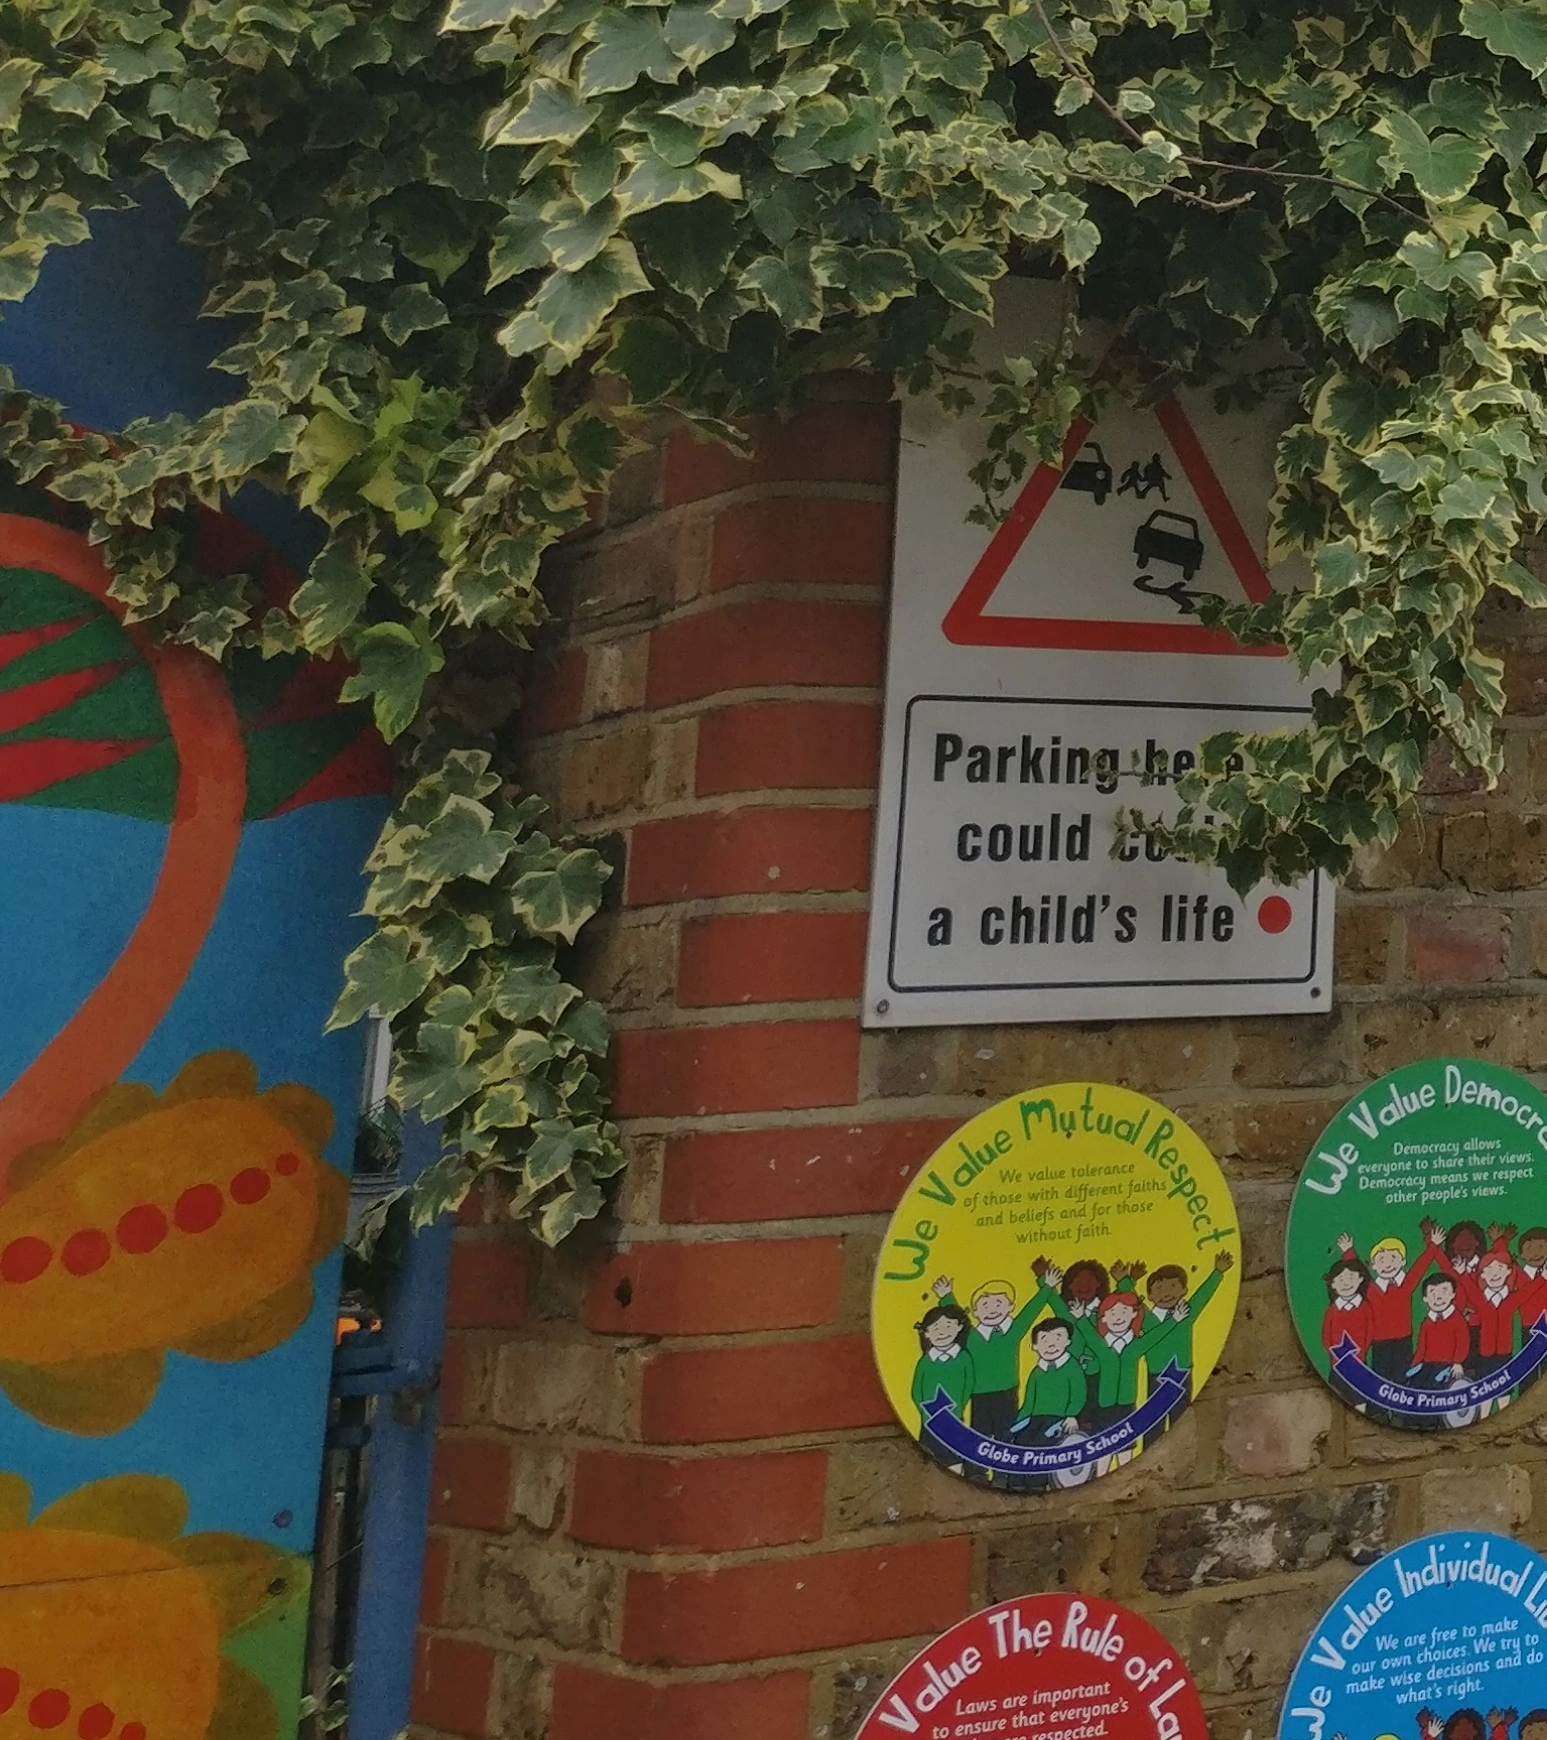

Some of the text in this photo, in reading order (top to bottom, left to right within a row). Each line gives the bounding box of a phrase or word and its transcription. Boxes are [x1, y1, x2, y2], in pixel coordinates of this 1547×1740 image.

[932, 733, 1244, 795] Parking hee
[956, 813, 1092, 864] could
[927, 892, 1235, 946] a child's life
[1305, 1142, 1359, 1194] We
[1348, 1083, 1436, 1140] Value
[1393, 1138, 1502, 1156] Democracy allows
[884, 1087, 1236, 1281] We Value Mutual Respect
[999, 1163, 1135, 1183] We value tolerance
[1358, 1150, 1535, 1177] everyone to share their views.
[1359, 1168, 1534, 1190] Democracy means we respect
[963, 1178, 1166, 1213] of those with different faiths
[976, 1201, 1154, 1226] and beliefs and for those
[1386, 1185, 1508, 1206] other people's views.
[1015, 1227, 1071, 1244] without
[1380, 1370, 1511, 1407] Globe Primary School
[978, 1422, 1134, 1465] Globe Primary School
[1394, 1541, 1534, 1598] Individual
[1311, 1587, 1394, 1671] Value
[1376, 1616, 1519, 1651] We are free to make
[878, 1601, 1186, 1740] Value The Rule of La
[1345, 1651, 1544, 1694] make wise decisions and do
[1352, 1634, 1539, 1675] our own choices. We try to
[955, 1682, 1111, 1716] Laws are important
[1396, 1679, 1484, 1705] what's right.
[932, 1697, 1130, 1739] to ensure that everyone's
[1291, 1686, 1332, 1740] We
